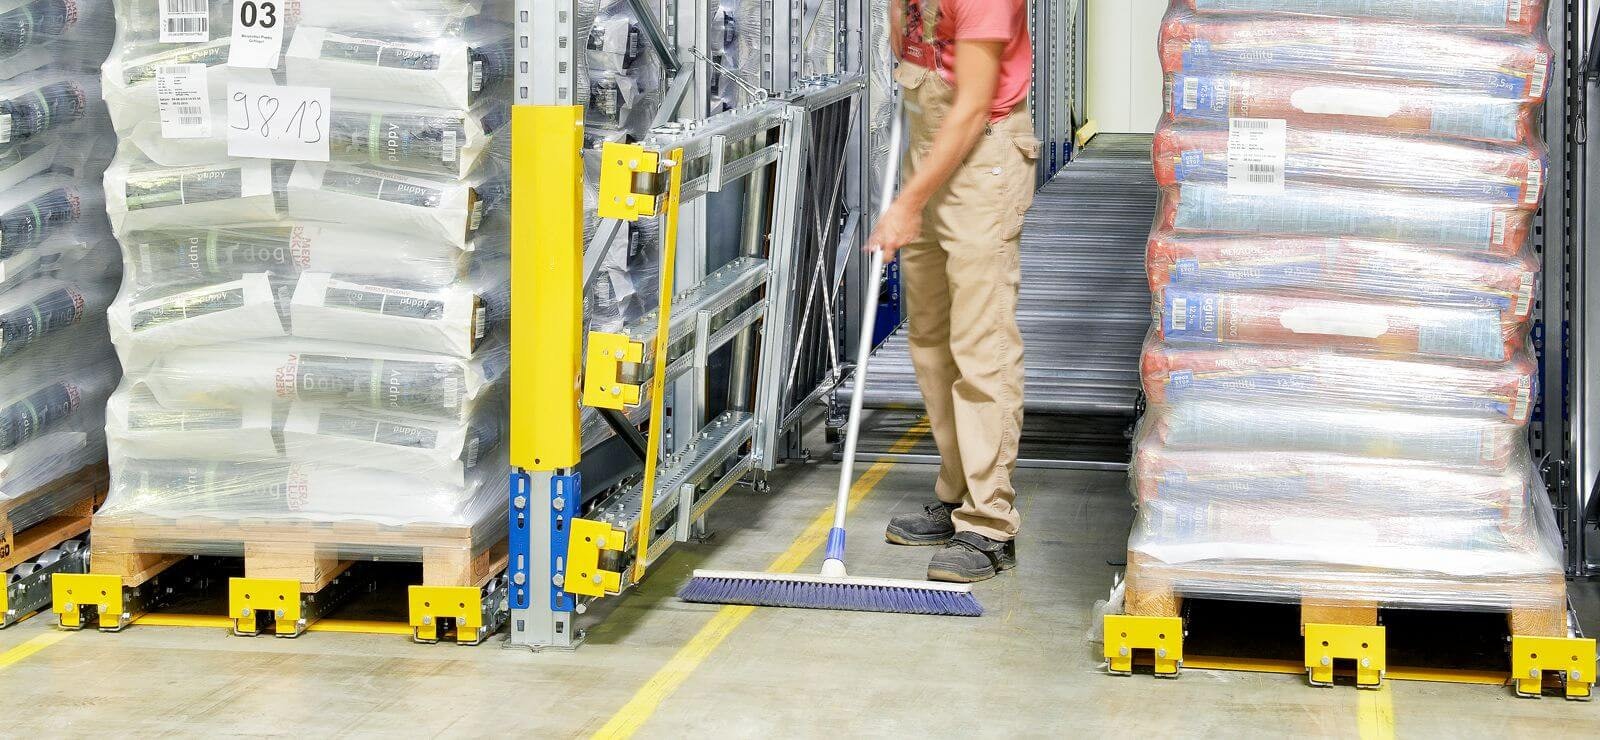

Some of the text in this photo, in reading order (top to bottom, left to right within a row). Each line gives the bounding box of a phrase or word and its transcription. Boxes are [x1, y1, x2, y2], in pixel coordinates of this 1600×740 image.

[240, 1, 276, 28] 03
[387, 122, 400, 162] puppy
[397, 183, 427, 196] puppy
[400, 297, 429, 309] puppy
[1203, 298, 1215, 332] agility
